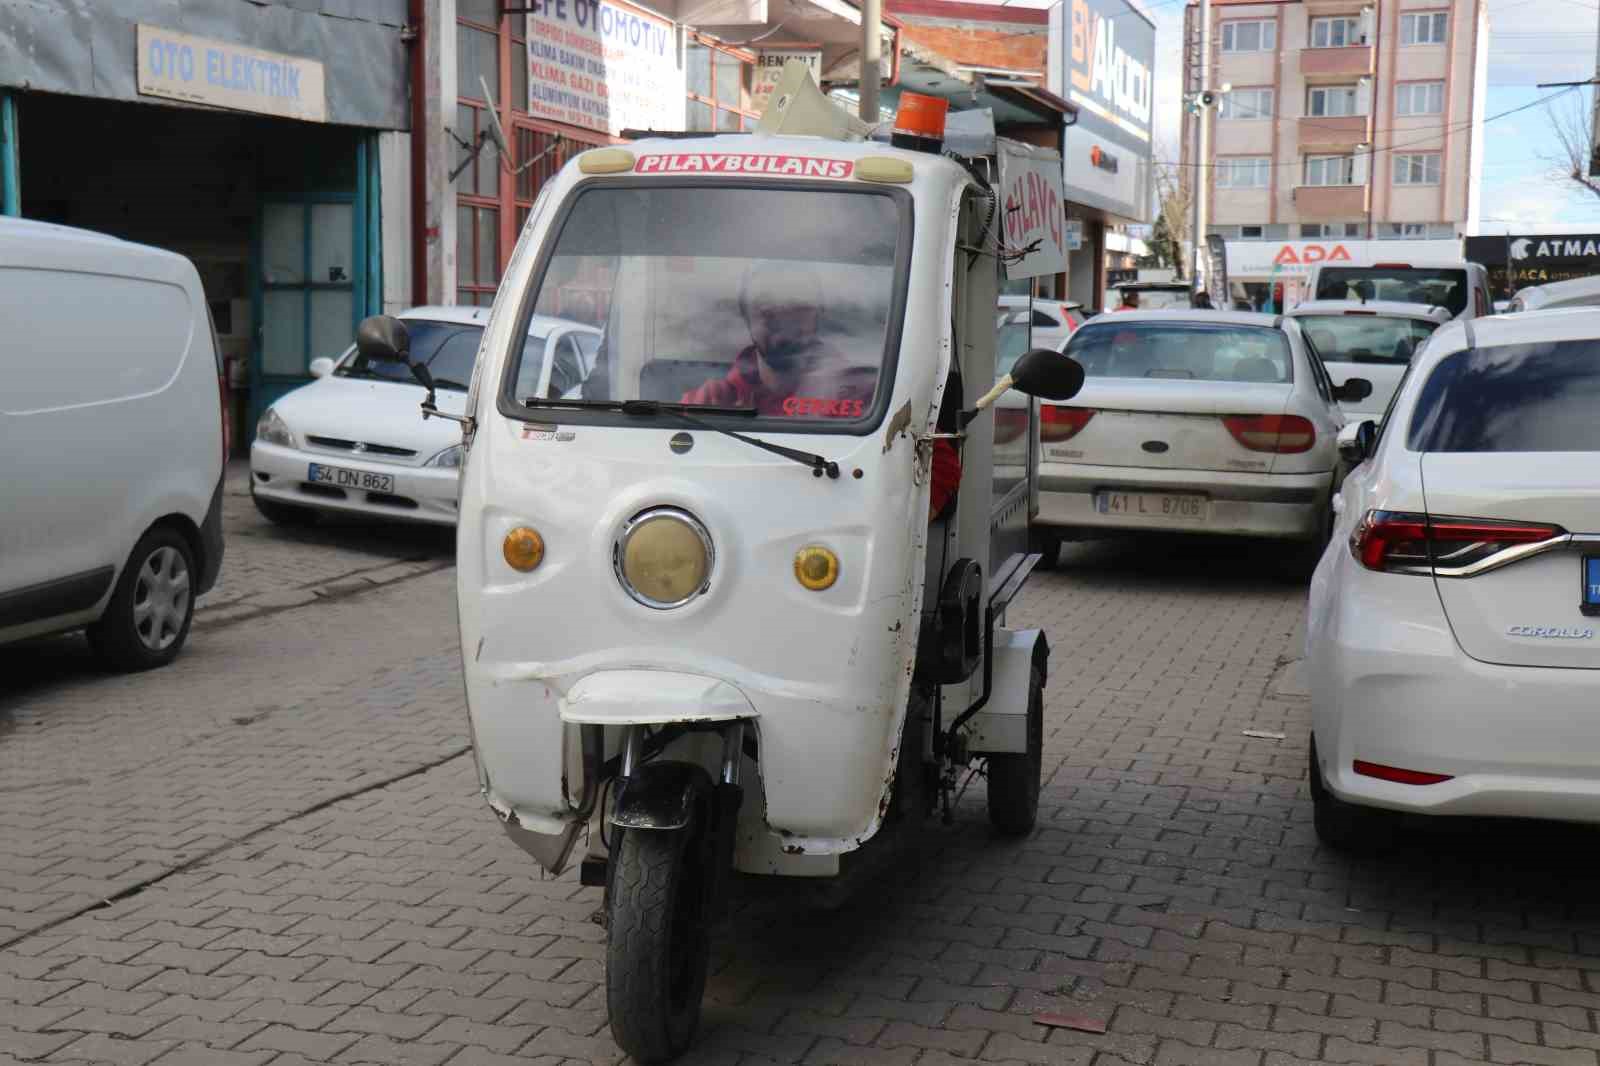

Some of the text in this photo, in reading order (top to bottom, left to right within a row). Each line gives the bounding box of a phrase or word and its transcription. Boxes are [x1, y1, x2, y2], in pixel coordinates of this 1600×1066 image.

[150, 38, 301, 97] OTO ELEKTRİK
[1275, 245, 1352, 264] ADA
[1536, 240, 1600, 257] ATMA
[316, 466, 390, 490] 54 DN 862
[1110, 494, 1129, 511] 41
[1506, 627, 1593, 640] COROLLA
